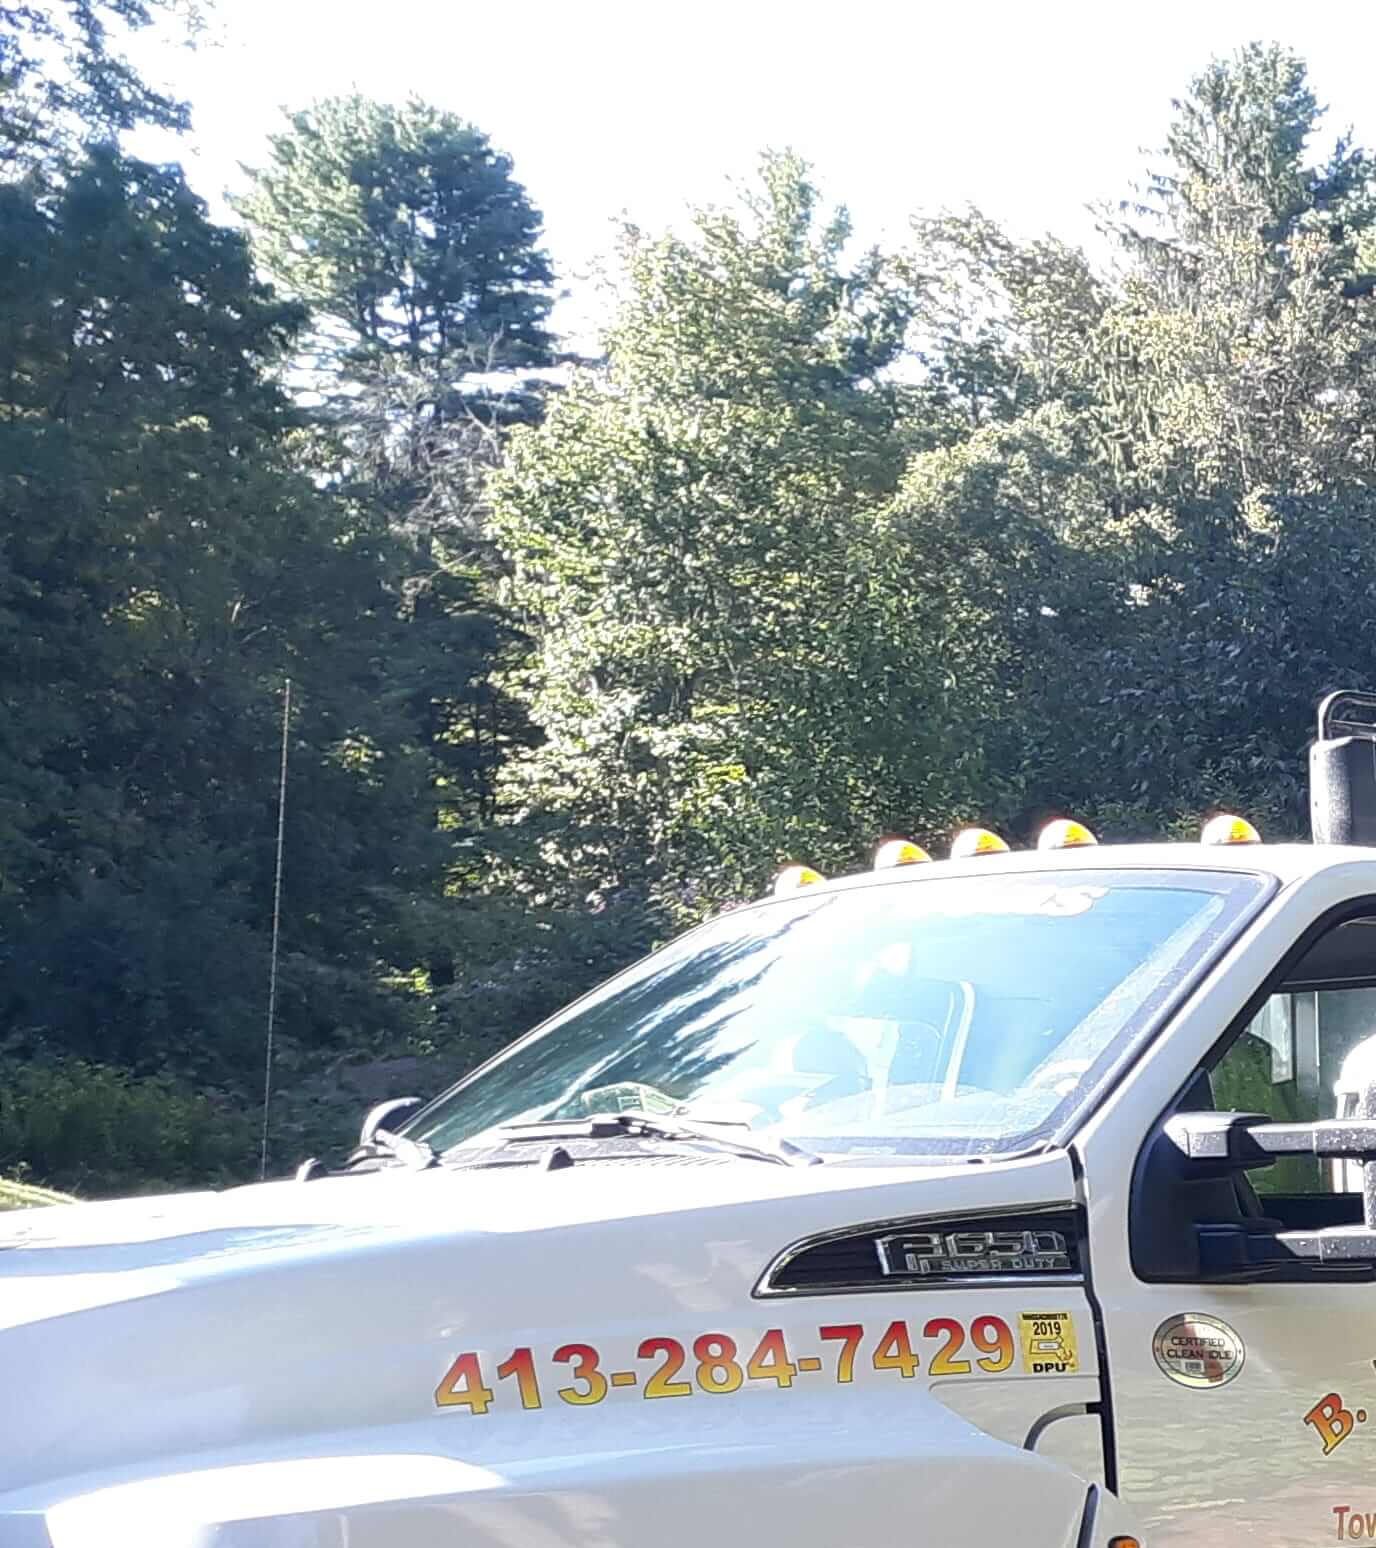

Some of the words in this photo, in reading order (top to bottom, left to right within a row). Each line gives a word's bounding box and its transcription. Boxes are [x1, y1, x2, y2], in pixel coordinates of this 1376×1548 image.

[942, 1259, 1001, 1272] SUPER
[1013, 1257, 1056, 1269] DUTY
[1032, 1321, 1061, 1336] 2019
[1171, 1336, 1225, 1347] CERTIFIED
[1167, 1349, 1203, 1360] CLEAN
[434, 1315, 1015, 1415] 413-284-7429
[1032, 1362, 1066, 1373] DPU
[1304, 1392, 1367, 1456] B.
